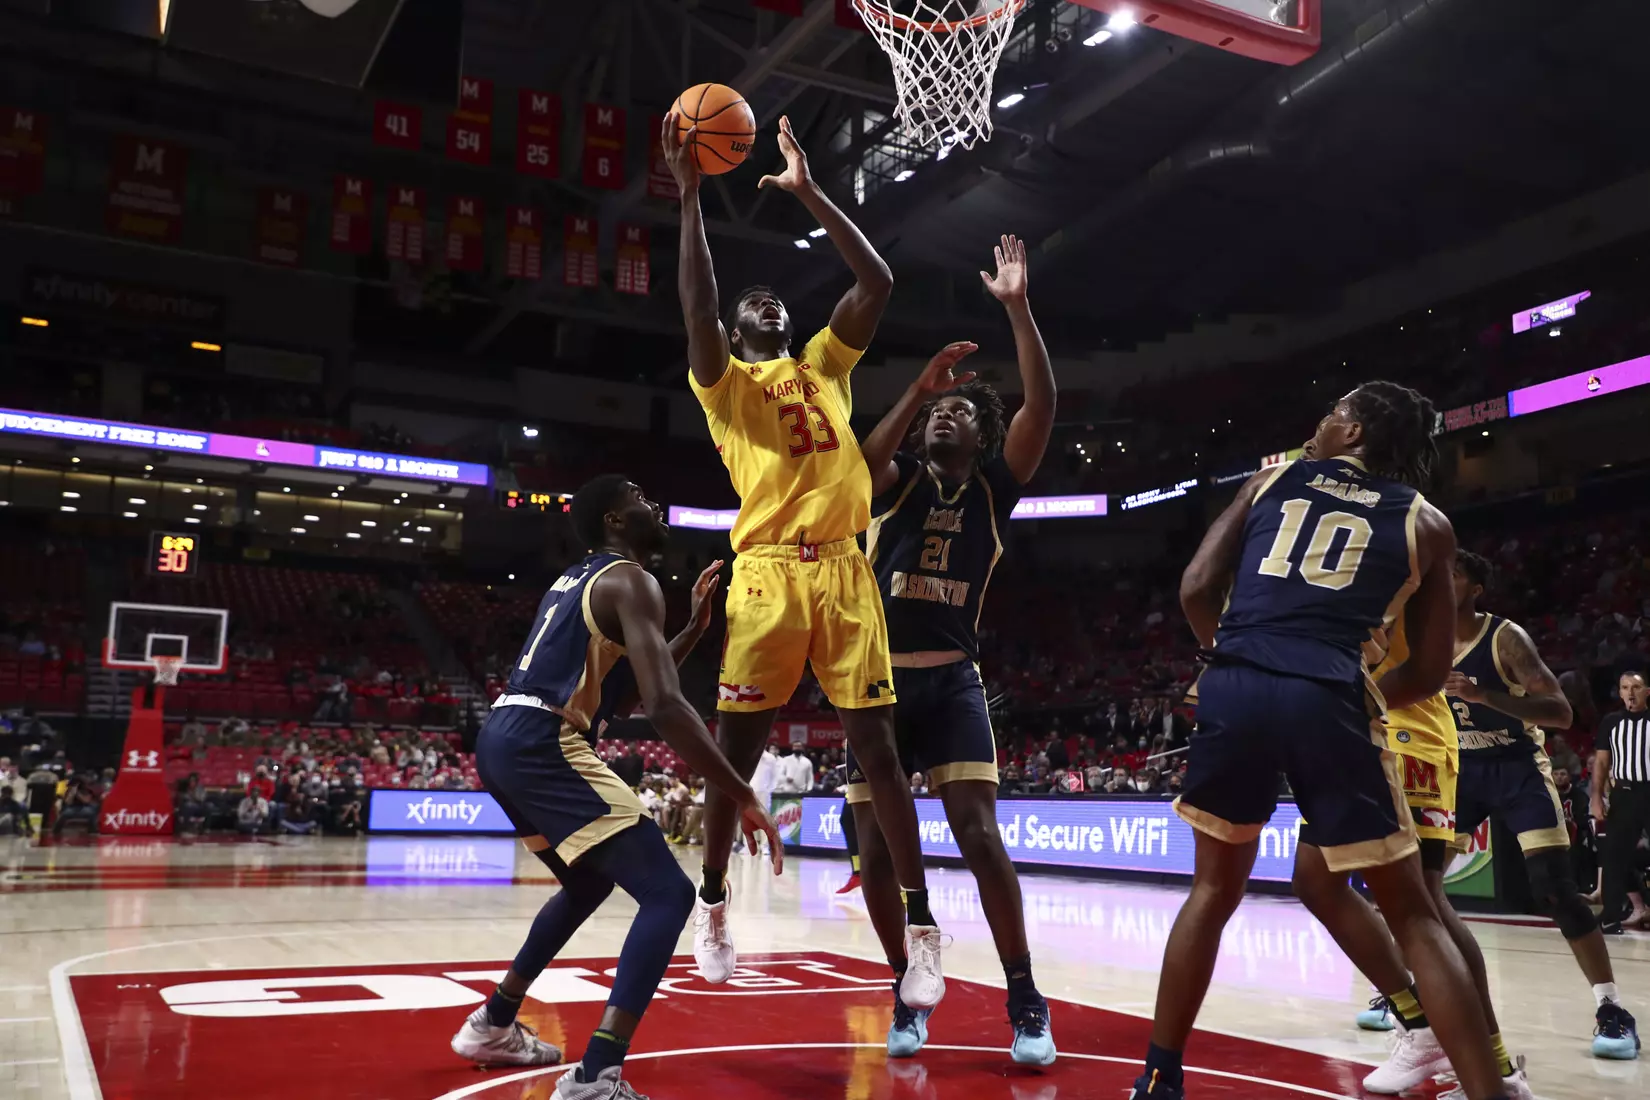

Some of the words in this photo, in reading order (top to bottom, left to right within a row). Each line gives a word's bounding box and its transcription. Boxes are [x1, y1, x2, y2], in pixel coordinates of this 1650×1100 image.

[462, 79, 480, 99] M
[531, 94, 549, 114] M
[384, 113, 410, 137] 41
[597, 108, 614, 127] M
[455, 129, 481, 153] 54
[134, 143, 167, 175] M
[526, 144, 550, 166] 25
[597, 157, 610, 177] 6
[345, 177, 363, 196] M
[398, 188, 416, 207] M
[458, 198, 474, 217] M
[517, 208, 532, 226] M
[574, 217, 589, 234] M
[626, 226, 641, 242] M
[108, 426, 156, 444] FREE
[777, 402, 840, 458] 33
[319, 450, 356, 467] JUST
[385, 459, 399, 472] A
[399, 459, 459, 479] MONTH
[1305, 473, 1381, 508] ADAMS
[1046, 500, 1096, 513] MONTH
[803, 545, 815, 559] M
[919, 535, 952, 572] 21
[1257, 498, 1374, 590] 10
[157, 549, 188, 573] 30
[518, 603, 559, 672] 1
[1402, 754, 1441, 793] M
[105, 808, 170, 830] xfinity
[406, 796, 483, 824] xfinity
[1024, 814, 1104, 852] Secure
[1109, 816, 1169, 856] WiFi
